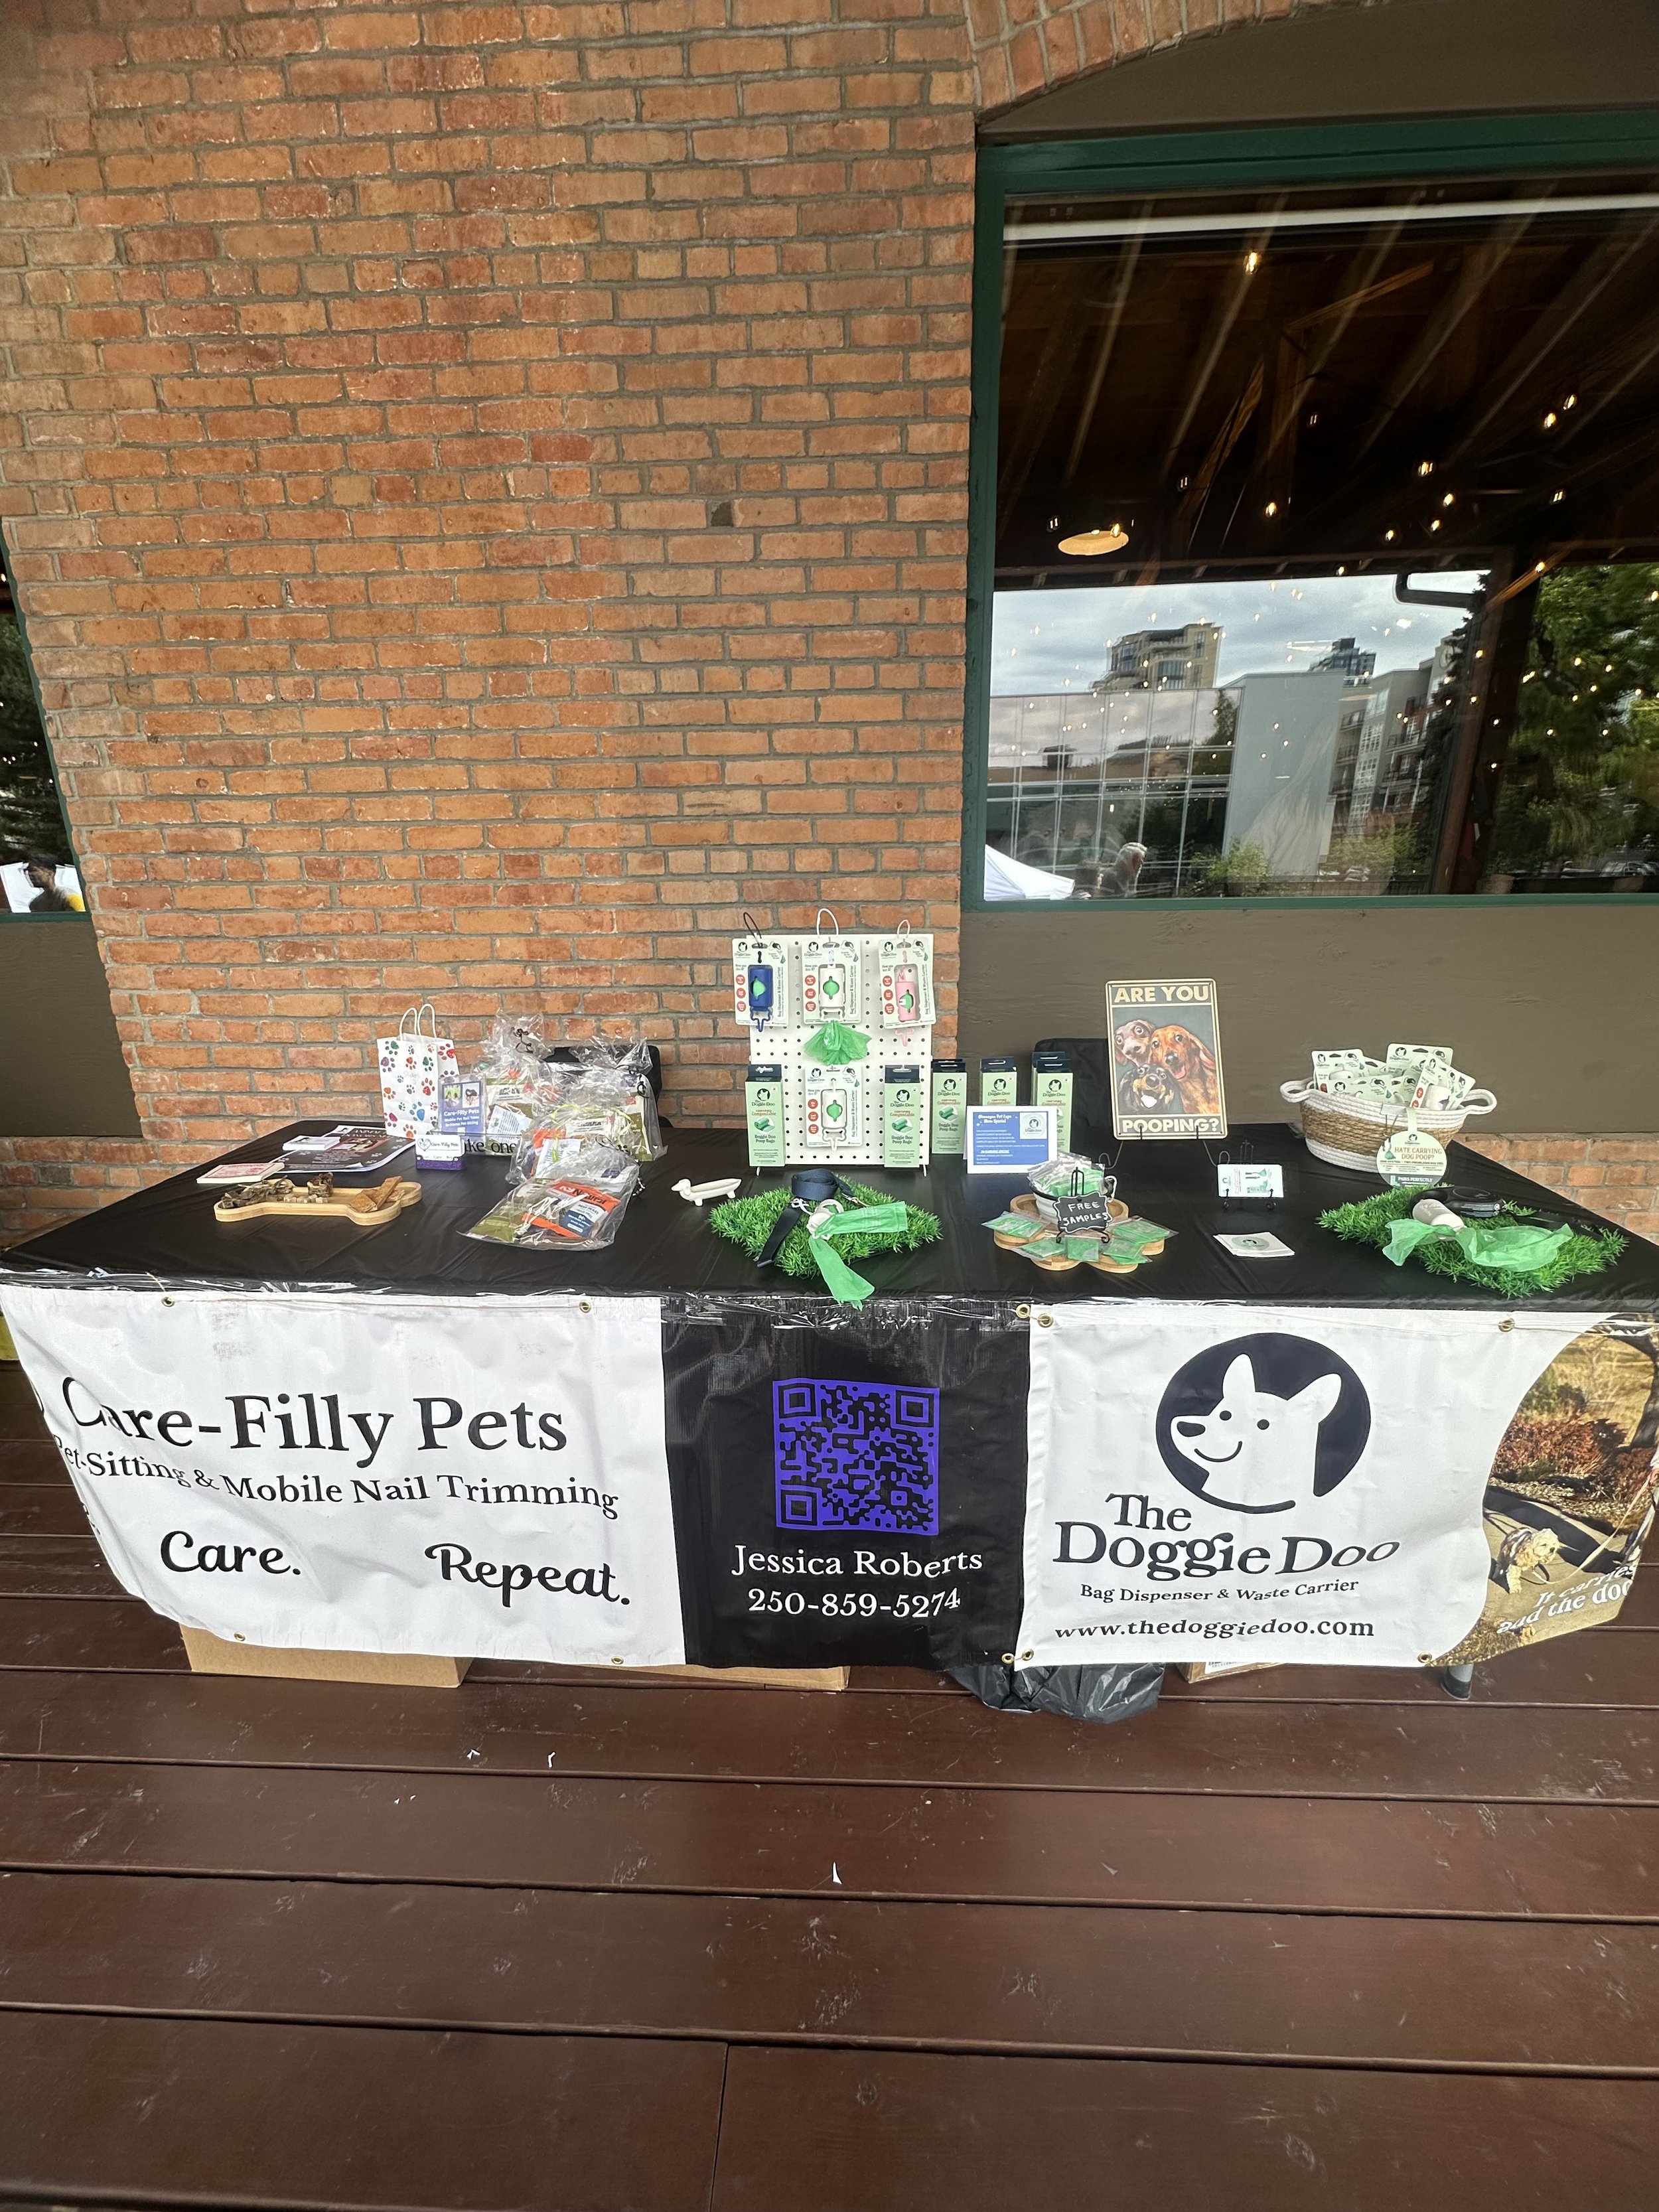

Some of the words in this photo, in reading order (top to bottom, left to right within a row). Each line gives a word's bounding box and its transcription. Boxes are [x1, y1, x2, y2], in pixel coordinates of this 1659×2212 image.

[1114, 987, 1156, 1003] ARE
[1161, 986, 1208, 1001] YOU
[1122, 1118, 1220, 1133] POOPING?
[559, 1185, 607, 1205] K9Nural
[1067, 1201, 1100, 1213] FREE
[1062, 1212, 1108, 1226] SAMPLES
[62, 1377, 395, 1468] Care-Filly
[413, 1397, 567, 1451] Pets
[194, 1469, 220, 1490] &
[220, 1474, 342, 1503] Mobile
[350, 1475, 431, 1503] Nail
[437, 1475, 619, 1520] Trimming
[1105, 1493, 1192, 1532] The
[731, 1544, 843, 1576] Jessica
[853, 1551, 983, 1578] Roberts
[1052, 1521, 1270, 1582] Doggie
[1275, 1536, 1400, 1575] Doo
[161, 1530, 302, 1576] Care.
[425, 1542, 630, 1607] Repeat.
[748, 1587, 961, 1618] 250-859-5274
[1080, 1584, 1115, 1603] Bag
[1120, 1588, 1213, 1603] Dispenser
[1216, 1588, 1230, 1599] &
[1236, 1588, 1290, 1600] Waste
[1295, 1579, 1360, 1597] Carrier
[1534, 1591, 1555, 1608] It
[1496, 1607, 1545, 1634] and
[1548, 1595, 1586, 1617] the
[1055, 1618, 1374, 1639] www.thedoggiedoo.com
